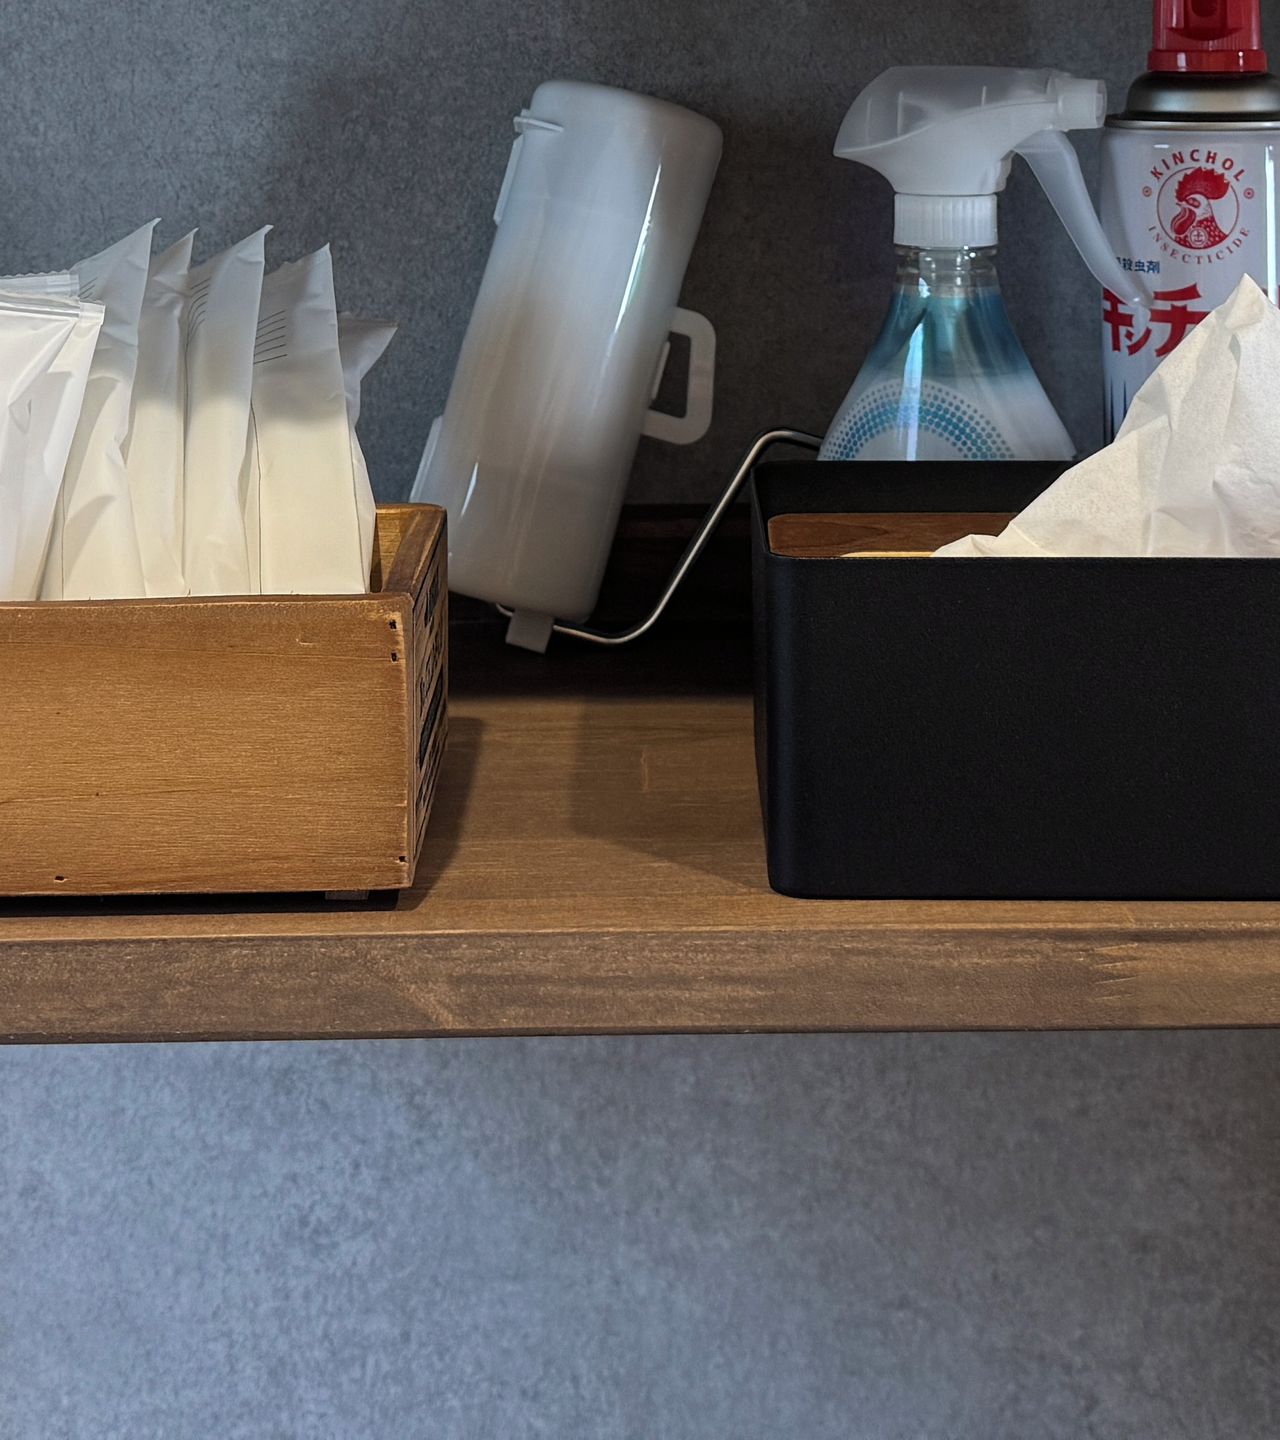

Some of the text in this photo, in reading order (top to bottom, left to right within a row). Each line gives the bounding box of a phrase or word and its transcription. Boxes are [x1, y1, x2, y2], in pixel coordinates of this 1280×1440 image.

[1150, 149, 1244, 181] KINCHOL
[1148, 225, 1250, 264] INSECTICIDE
[1116, 256, 1160, 274] 殺虫剤
